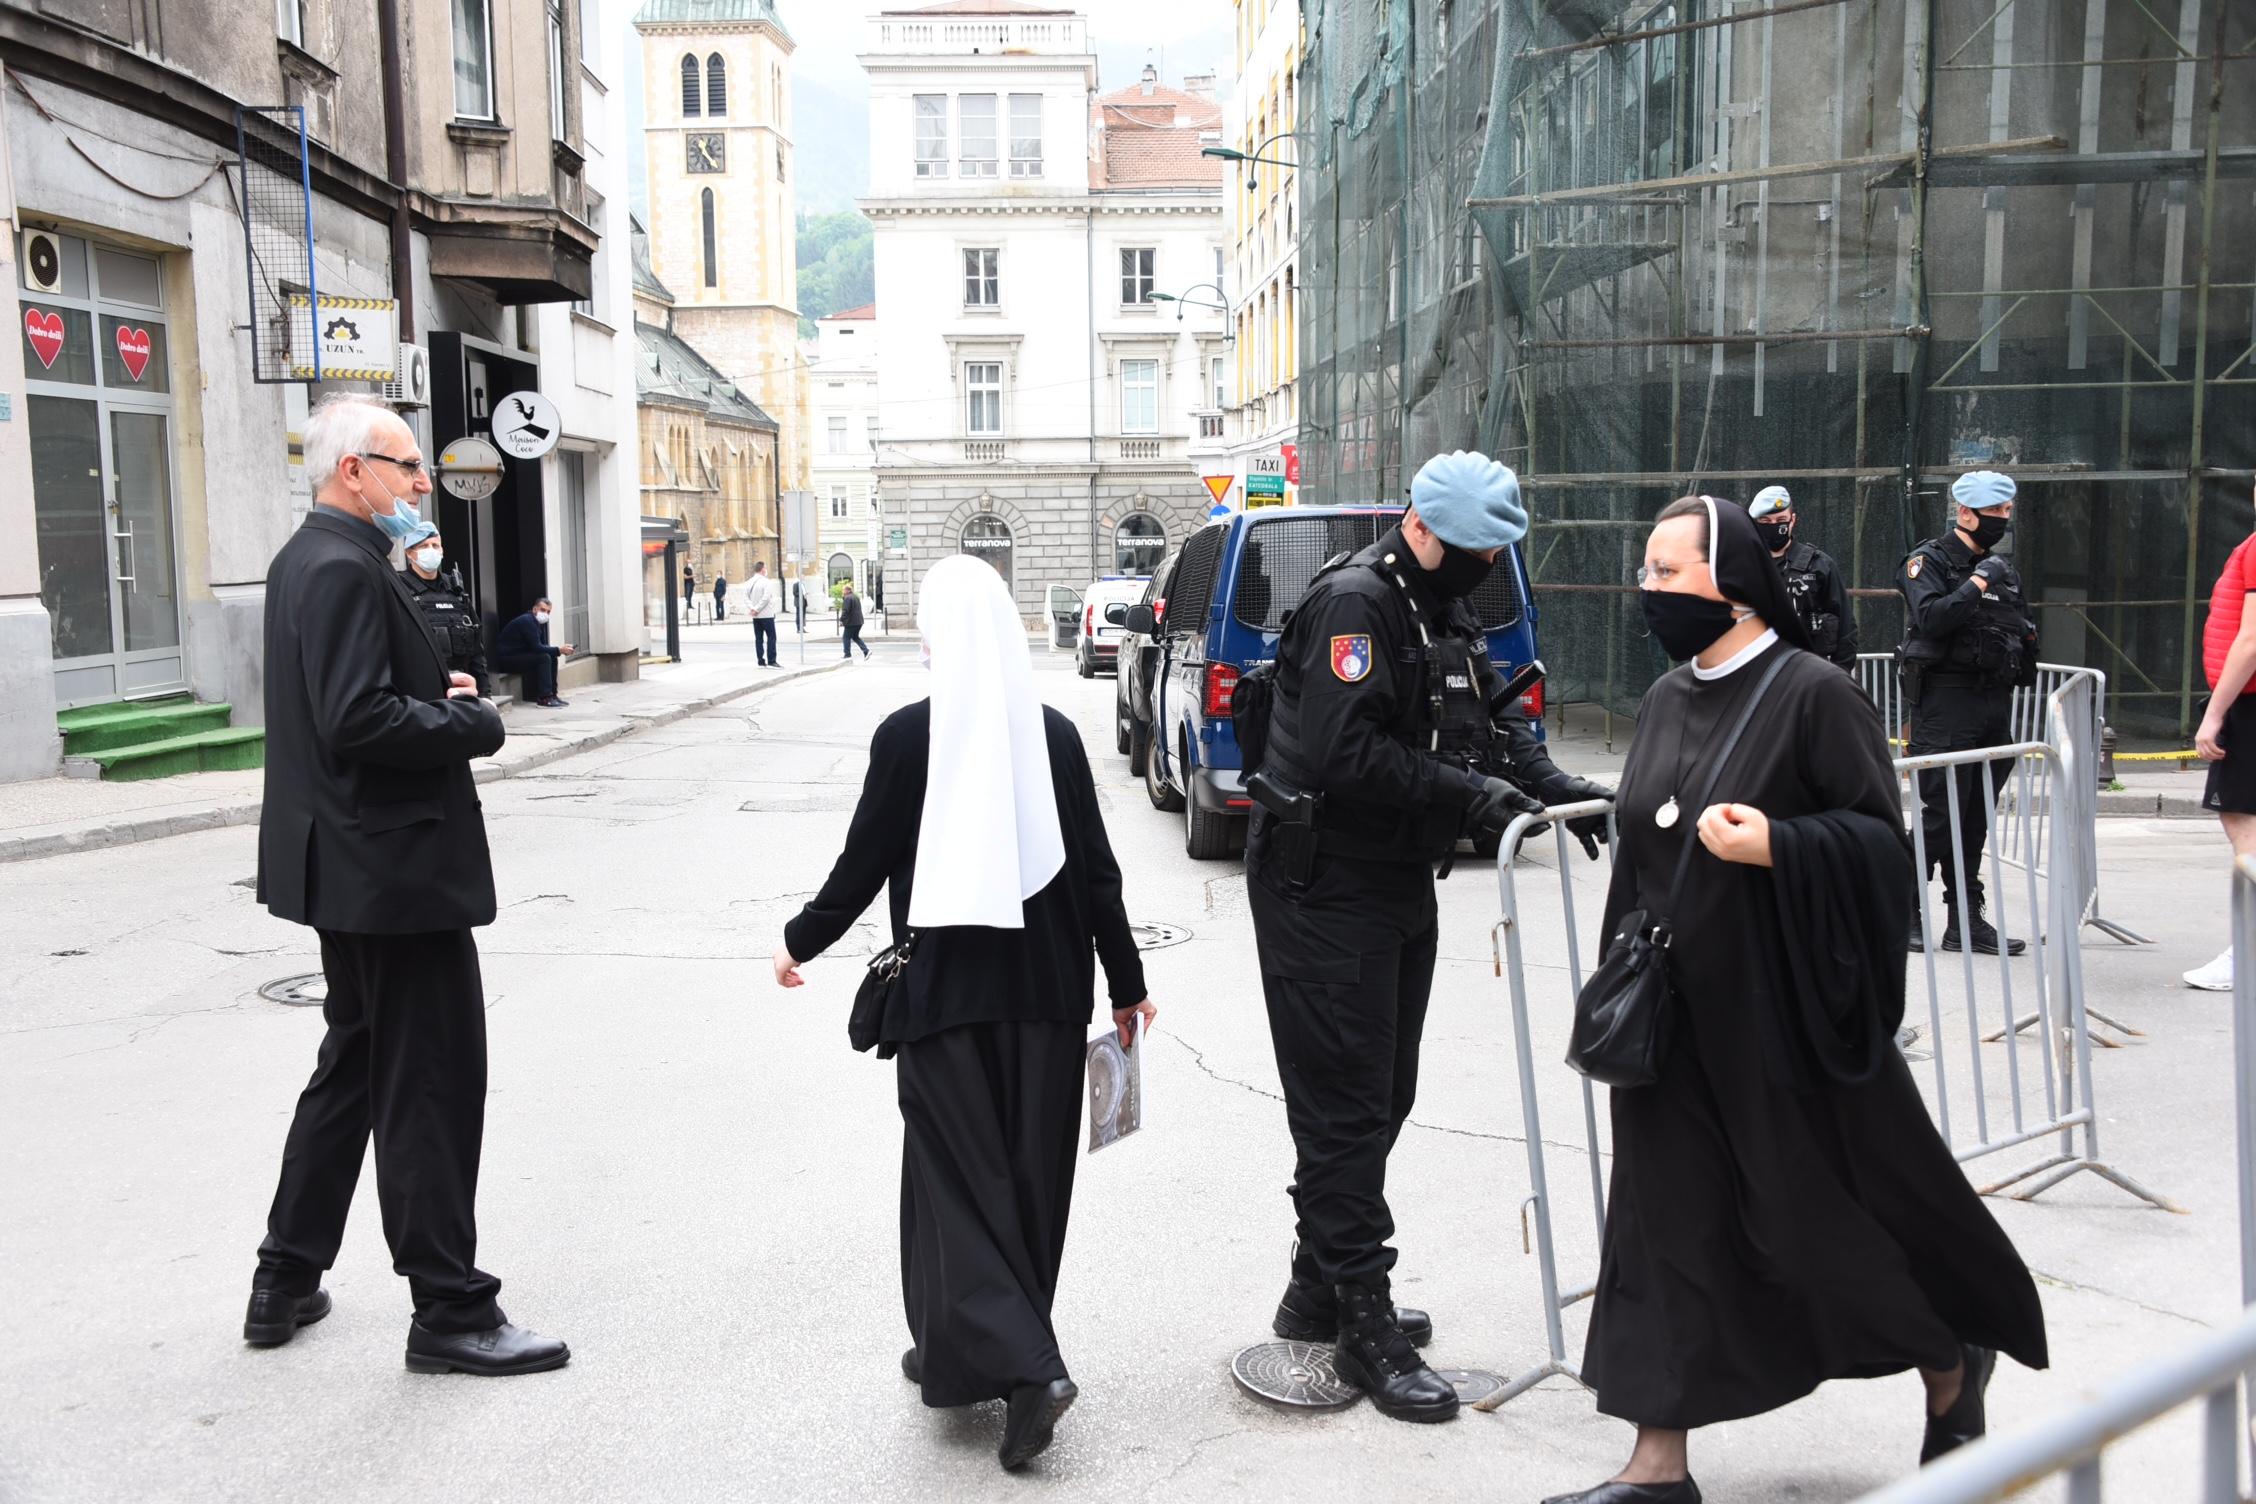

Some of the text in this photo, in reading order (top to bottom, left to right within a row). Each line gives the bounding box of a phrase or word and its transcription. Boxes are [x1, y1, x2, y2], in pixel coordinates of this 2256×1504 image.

[326, 344, 354, 353] UZUN
[509, 434, 539, 444] Maison
[515, 444, 534, 453] Coco
[1255, 459, 1279, 472] TAXI
[1446, 675, 1469, 689] POLICIJA
